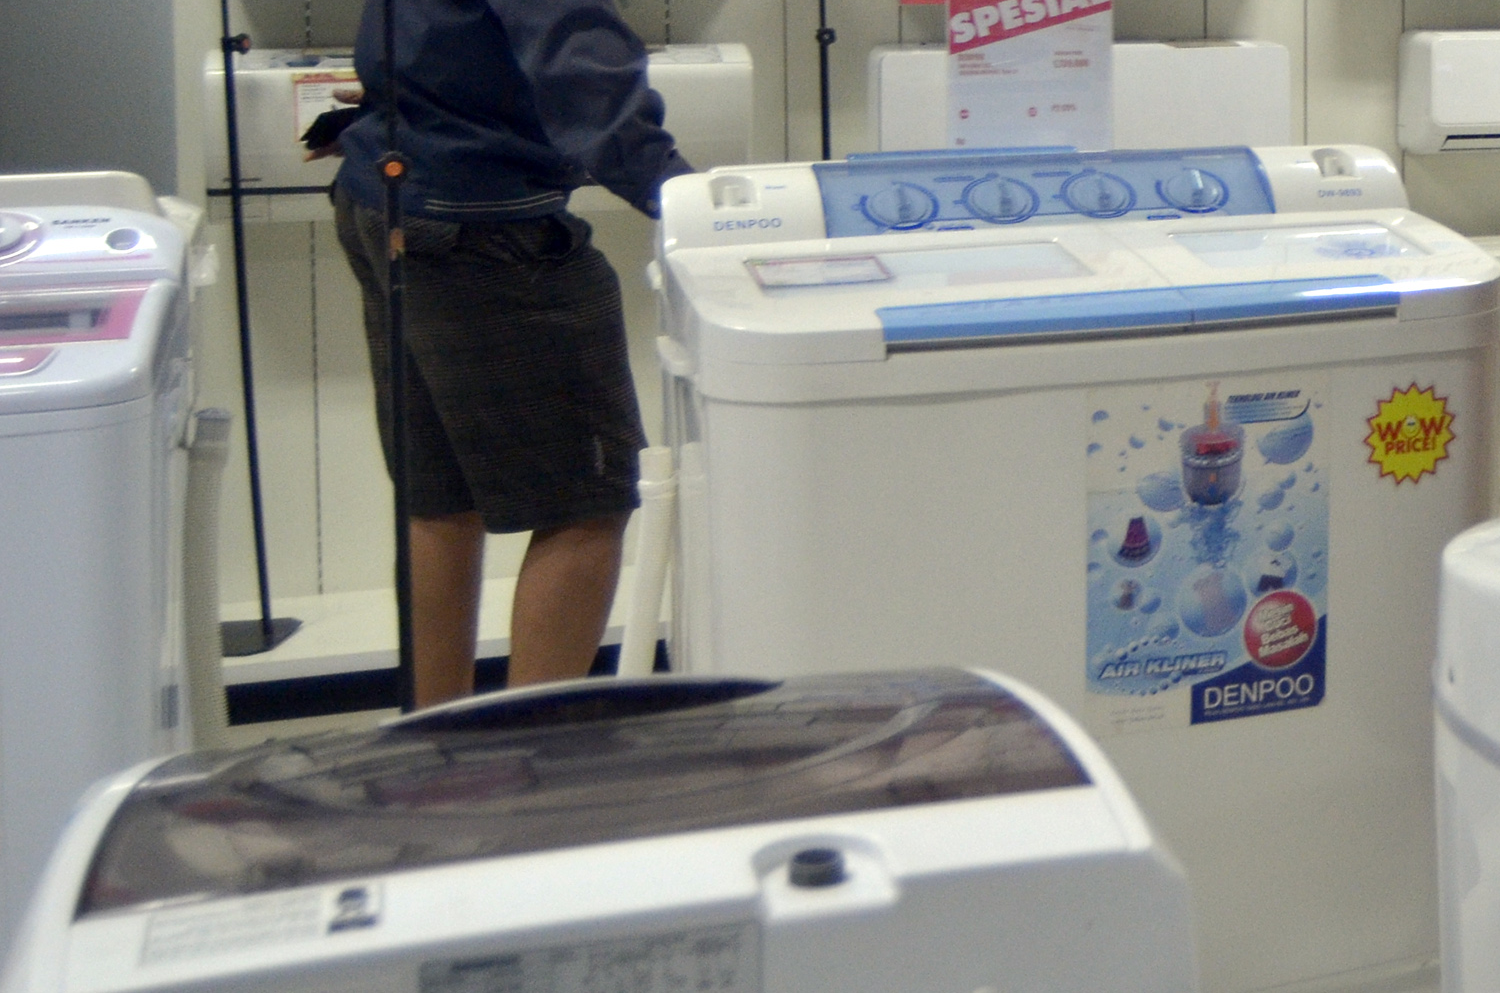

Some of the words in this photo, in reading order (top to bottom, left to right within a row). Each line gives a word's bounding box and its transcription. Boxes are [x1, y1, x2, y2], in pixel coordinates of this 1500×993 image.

[713, 217, 782, 232] DENPOO
[1376, 415, 1446, 442] WOW
[1385, 436, 1437, 457] PRICE!
[1100, 662, 1142, 680] AIR
[1146, 654, 1226, 675] KLINER
[1203, 673, 1315, 709] DENPOO
